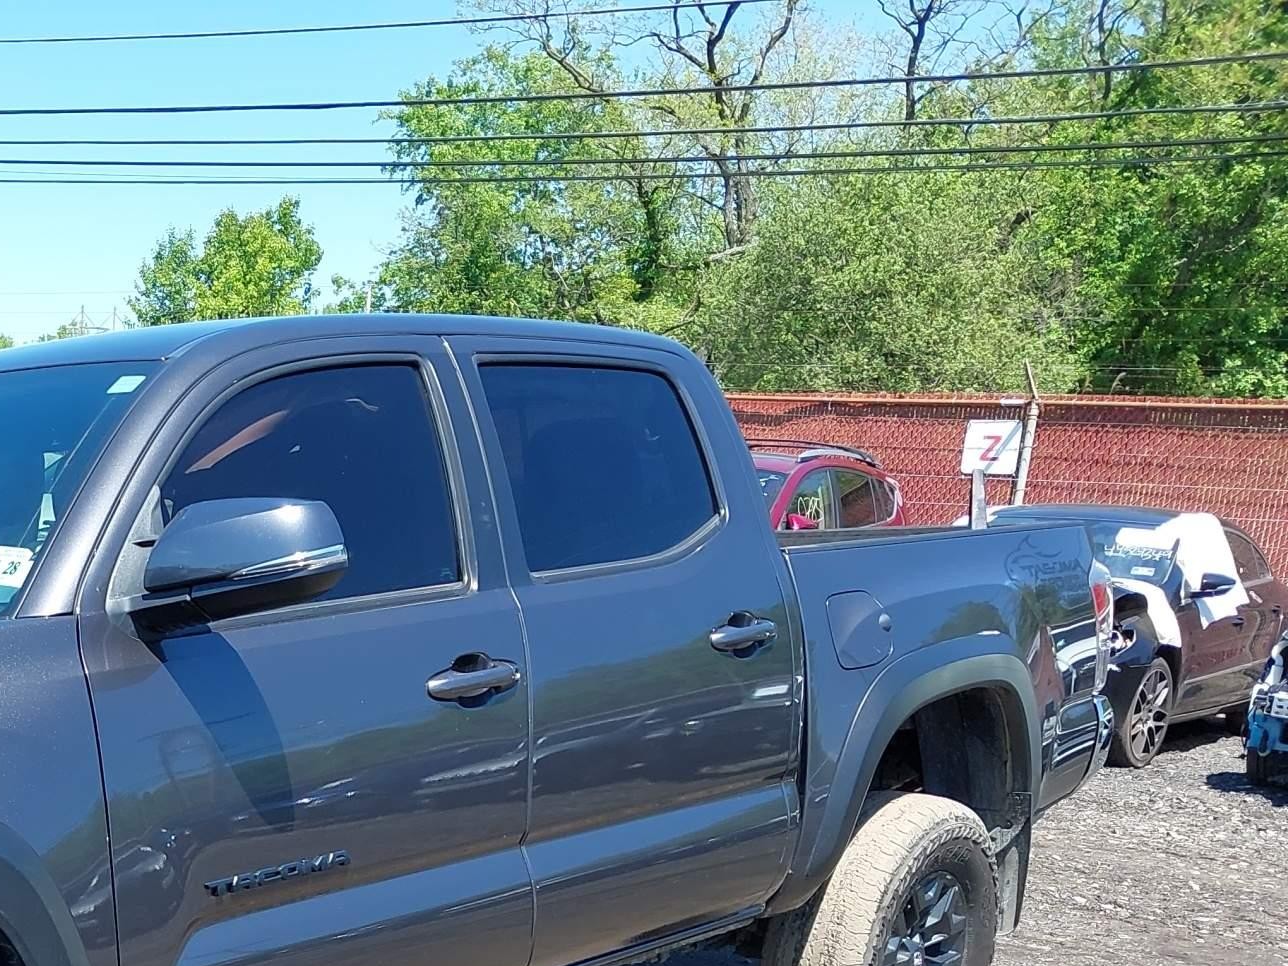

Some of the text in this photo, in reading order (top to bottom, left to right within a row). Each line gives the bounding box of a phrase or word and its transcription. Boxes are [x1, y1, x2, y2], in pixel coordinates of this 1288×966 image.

[978, 435, 1003, 462] Z
[2, 560, 22, 575] 28
[203, 849, 352, 897] TACOMA
